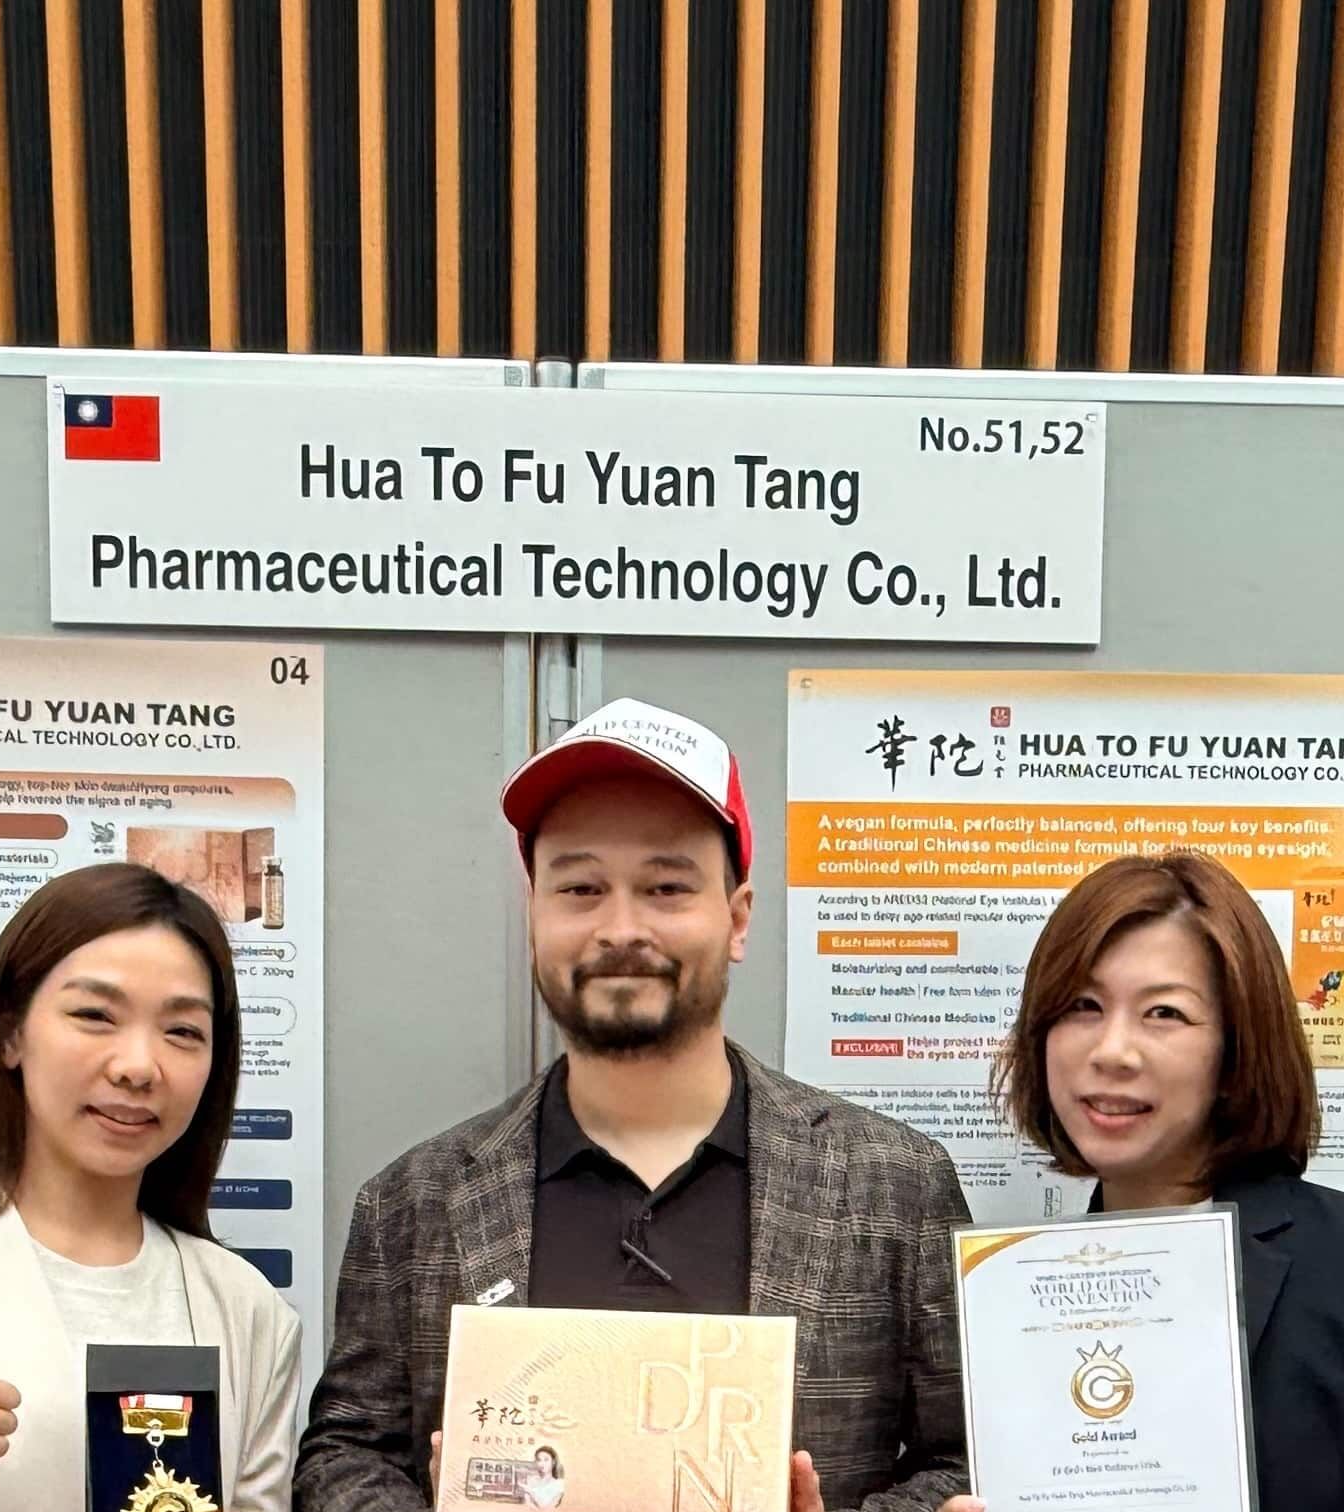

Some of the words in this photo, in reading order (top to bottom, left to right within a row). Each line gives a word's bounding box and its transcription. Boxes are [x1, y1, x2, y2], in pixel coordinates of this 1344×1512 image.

[919, 415, 1085, 458] No.51,52
[301, 443, 402, 502] Hua
[422, 446, 482, 504] To
[505, 450, 565, 506] Fu
[585, 451, 714, 509] Yuan
[735, 455, 859, 524] Tang
[90, 535, 501, 599] Pharmaceutical
[523, 544, 827, 618] Technology
[847, 554, 946, 615] Co.,
[968, 556, 1060, 610] Ltd.
[271, 657, 309, 685] 04
[45, 700, 135, 724] YUAN
[146, 703, 235, 727] TANG
[33, 730, 160, 747] TECHNOLOGY
[1020, 734, 1086, 756] HUA
[1097, 735, 1137, 756] TO
[1149, 736, 1188, 758] FU
[1200, 736, 1286, 759] YUAN
[1018, 763, 1182, 779] PHARMACEUTICAL
[1188, 765, 1307, 781] TECHNOLOGY
[66, 795, 85, 805] the
[818, 815, 832, 829] A
[835, 817, 885, 834] vegan
[891, 815, 958, 832] formula,
[963, 816, 1034, 834] perfectly
[1040, 817, 1117, 835] balanced,
[1123, 818, 1187, 837] offering
[1192, 819, 1225, 834] four
[1231, 819, 1258, 837] key
[818, 838, 831, 851] A
[835, 838, 918, 852] traditional
[924, 838, 990, 853] Chinese
[995, 839, 1069, 854] medicine
[1075, 839, 1138, 855] formula
[1142, 840, 1164, 855] for
[818, 860, 900, 875] combined
[906, 860, 939, 875] with
[944, 861, 1007, 876] modern
[1011, 861, 1084, 878] patented
[906, 963, 927, 975] and
[880, 986, 916, 997] health
[832, 1012, 891, 1024] Traditional
[895, 1012, 941, 1024] Chinese
[945, 1012, 996, 1024] Medicine
